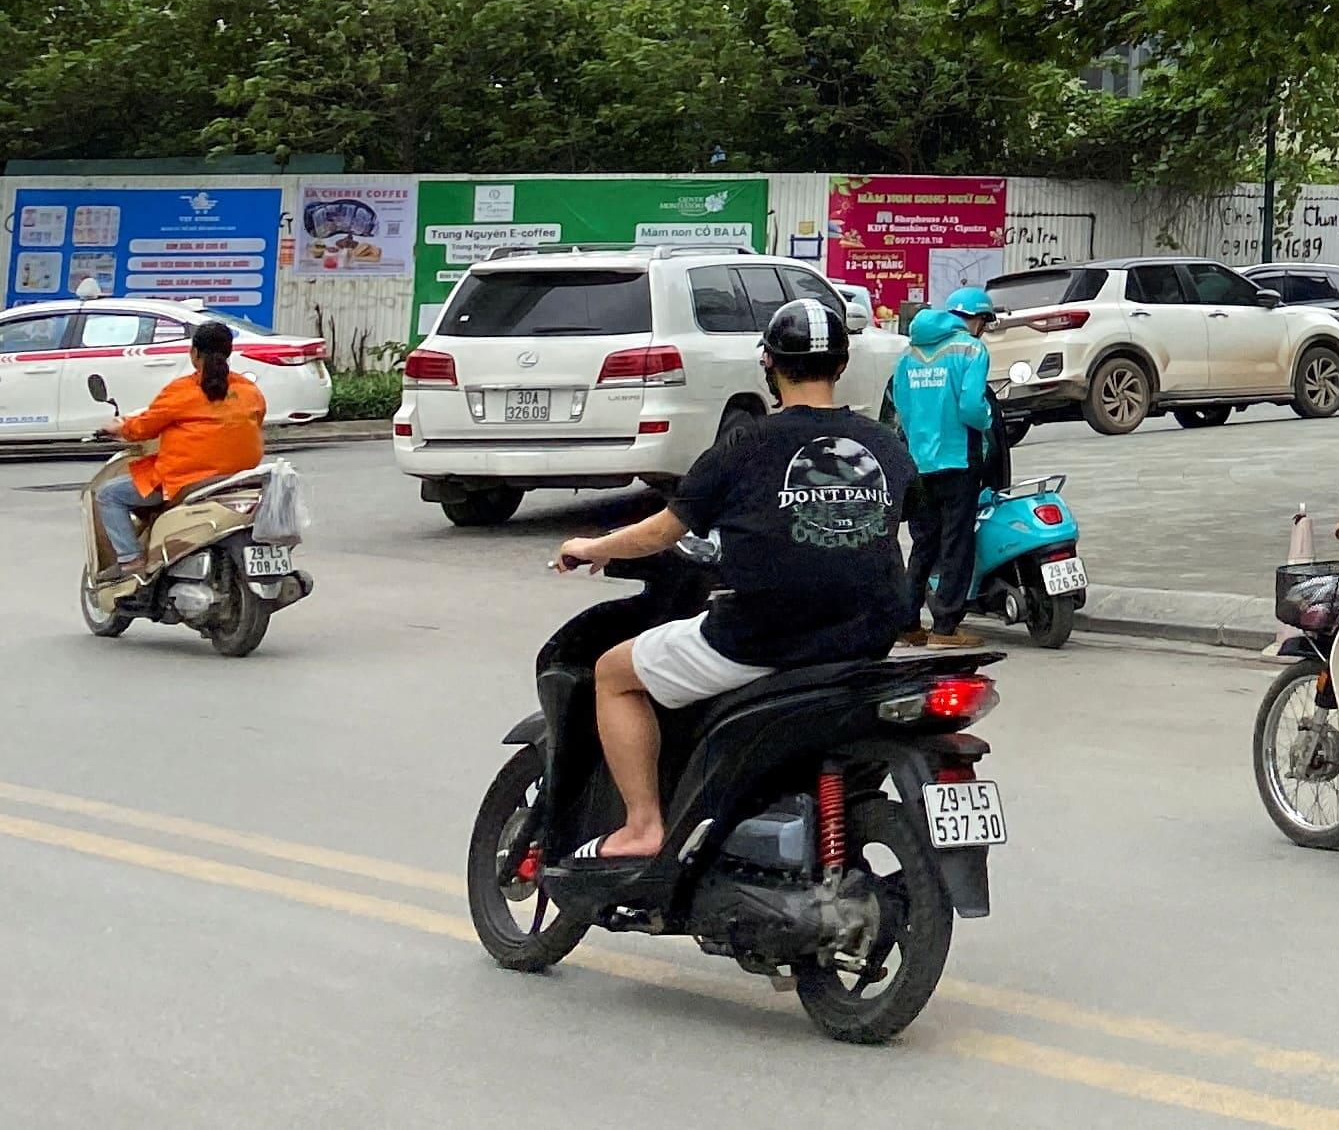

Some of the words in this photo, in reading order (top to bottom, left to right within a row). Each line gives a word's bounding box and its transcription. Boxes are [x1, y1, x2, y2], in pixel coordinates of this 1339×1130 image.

[322, 189, 363, 199] CHERIE
[366, 189, 409, 199] COFFEE
[431, 229, 462, 241] Trung
[509, 227, 556, 238] E-coffee
[671, 229, 692, 237] non
[713, 227, 730, 237] BA
[889, 224, 928, 233] Sunshine
[930, 224, 948, 233] City
[954, 224, 987, 233] Ciputra
[517, 391, 539, 405] 30A
[777, 488, 841, 509] DON'T
[844, 488, 893, 507] PANIC
[936, 785, 991, 813] 29-L5
[935, 813, 1001, 843] 537.30
